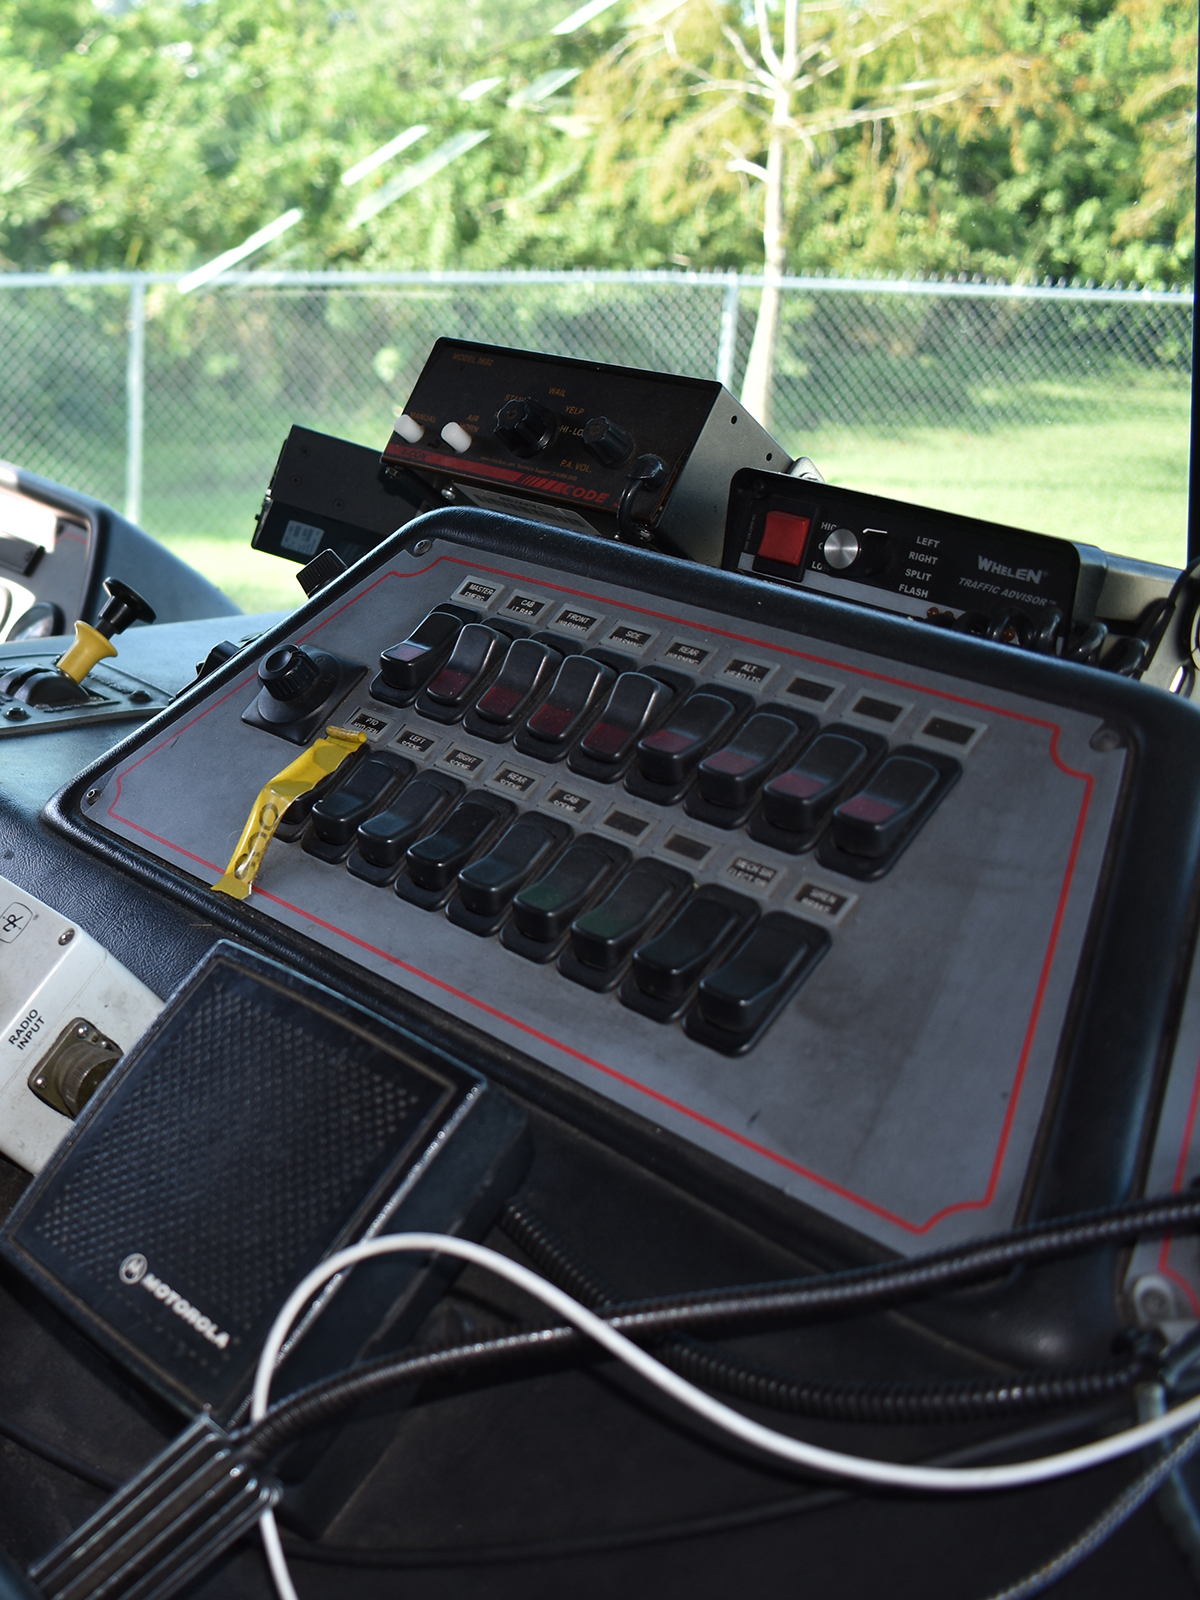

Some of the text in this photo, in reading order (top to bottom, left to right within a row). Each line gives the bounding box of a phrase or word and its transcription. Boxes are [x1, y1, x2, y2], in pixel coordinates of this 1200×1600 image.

[452, 353, 476, 364] MODEL
[548, 387, 566, 398] WAIL
[565, 405, 585, 416] YELP
[410, 412, 436, 423] MANUAL
[466, 414, 480, 422] AIR
[575, 462, 592, 473] VOL.
[561, 485, 610, 504] CODE
[916, 536, 940, 549] LEFT
[908, 551, 938, 566] RIGHT
[905, 568, 932, 582] SPLIT
[977, 555, 1042, 585] WHELEN
[470, 583, 495, 596] MASTER
[898, 584, 929, 599] FLASH
[958, 576, 1047, 607] TRAFFIC ADVISOR
[520, 600, 535, 608] CAB
[566, 612, 590, 624] FRONT
[625, 630, 642, 640] SIDE
[678, 645, 699, 657] REAR
[365, 718, 379, 726] PTO
[409, 735, 426, 744] LEFT
[456, 752, 477, 764] RIGHT
[507, 772, 528, 783] REAR
[563, 794, 580, 804] CAB
[8, 1009, 38, 1045] RADIO
[16, 1016, 45, 1051] INPUT
[140, 1272, 230, 1350] MOTOROLA
